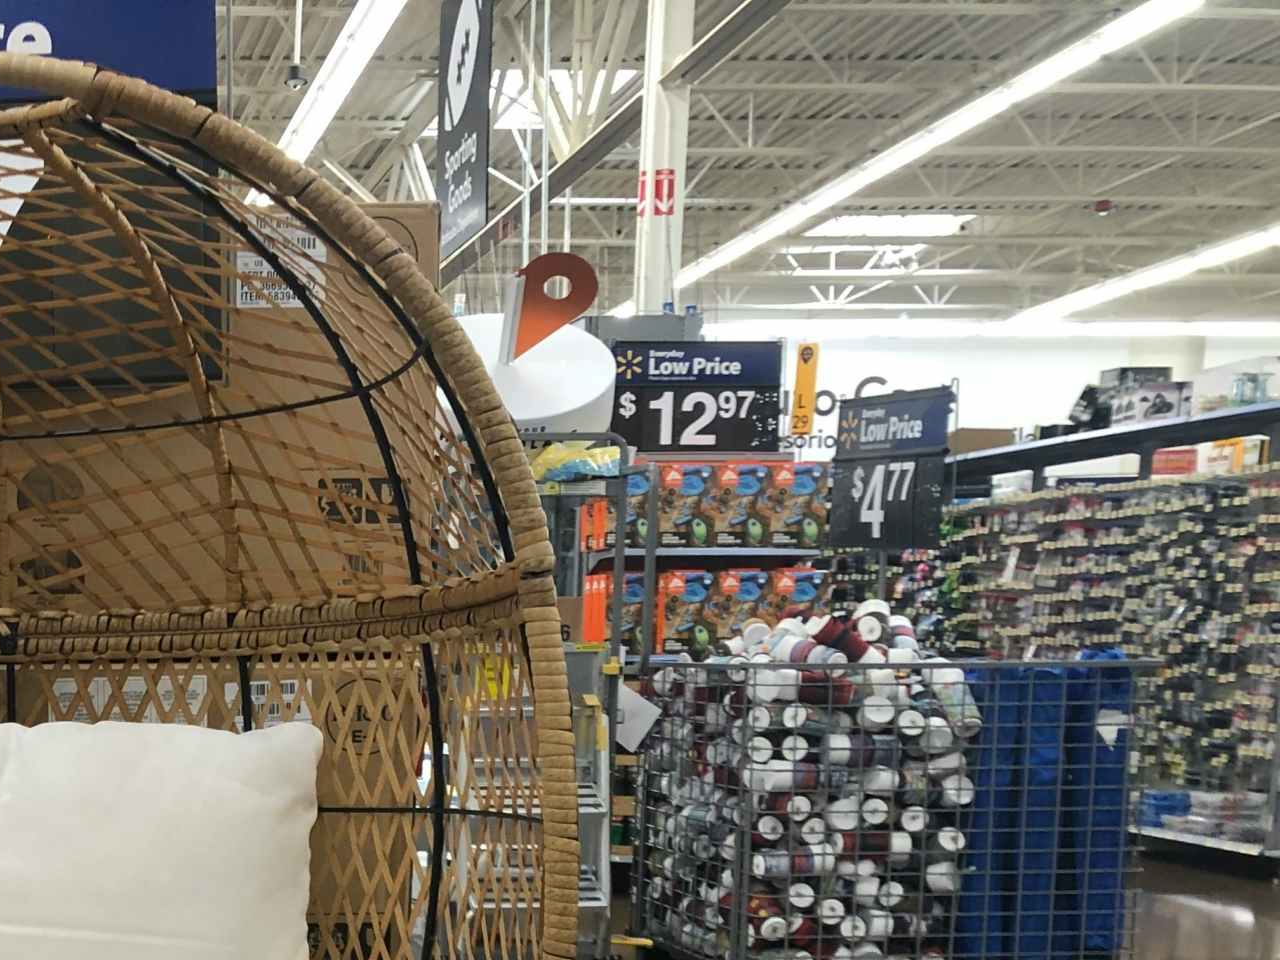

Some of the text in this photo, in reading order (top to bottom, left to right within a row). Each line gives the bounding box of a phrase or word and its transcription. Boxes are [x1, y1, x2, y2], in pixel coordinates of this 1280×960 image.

[445, 132, 478, 185] Sporting
[448, 169, 472, 214] Goods
[648, 350, 685, 359] Everyday
[648, 357, 741, 375] Low Price
[797, 393, 808, 409] L
[792, 415, 809, 430] 29
[860, 414, 923, 443] Low Price
